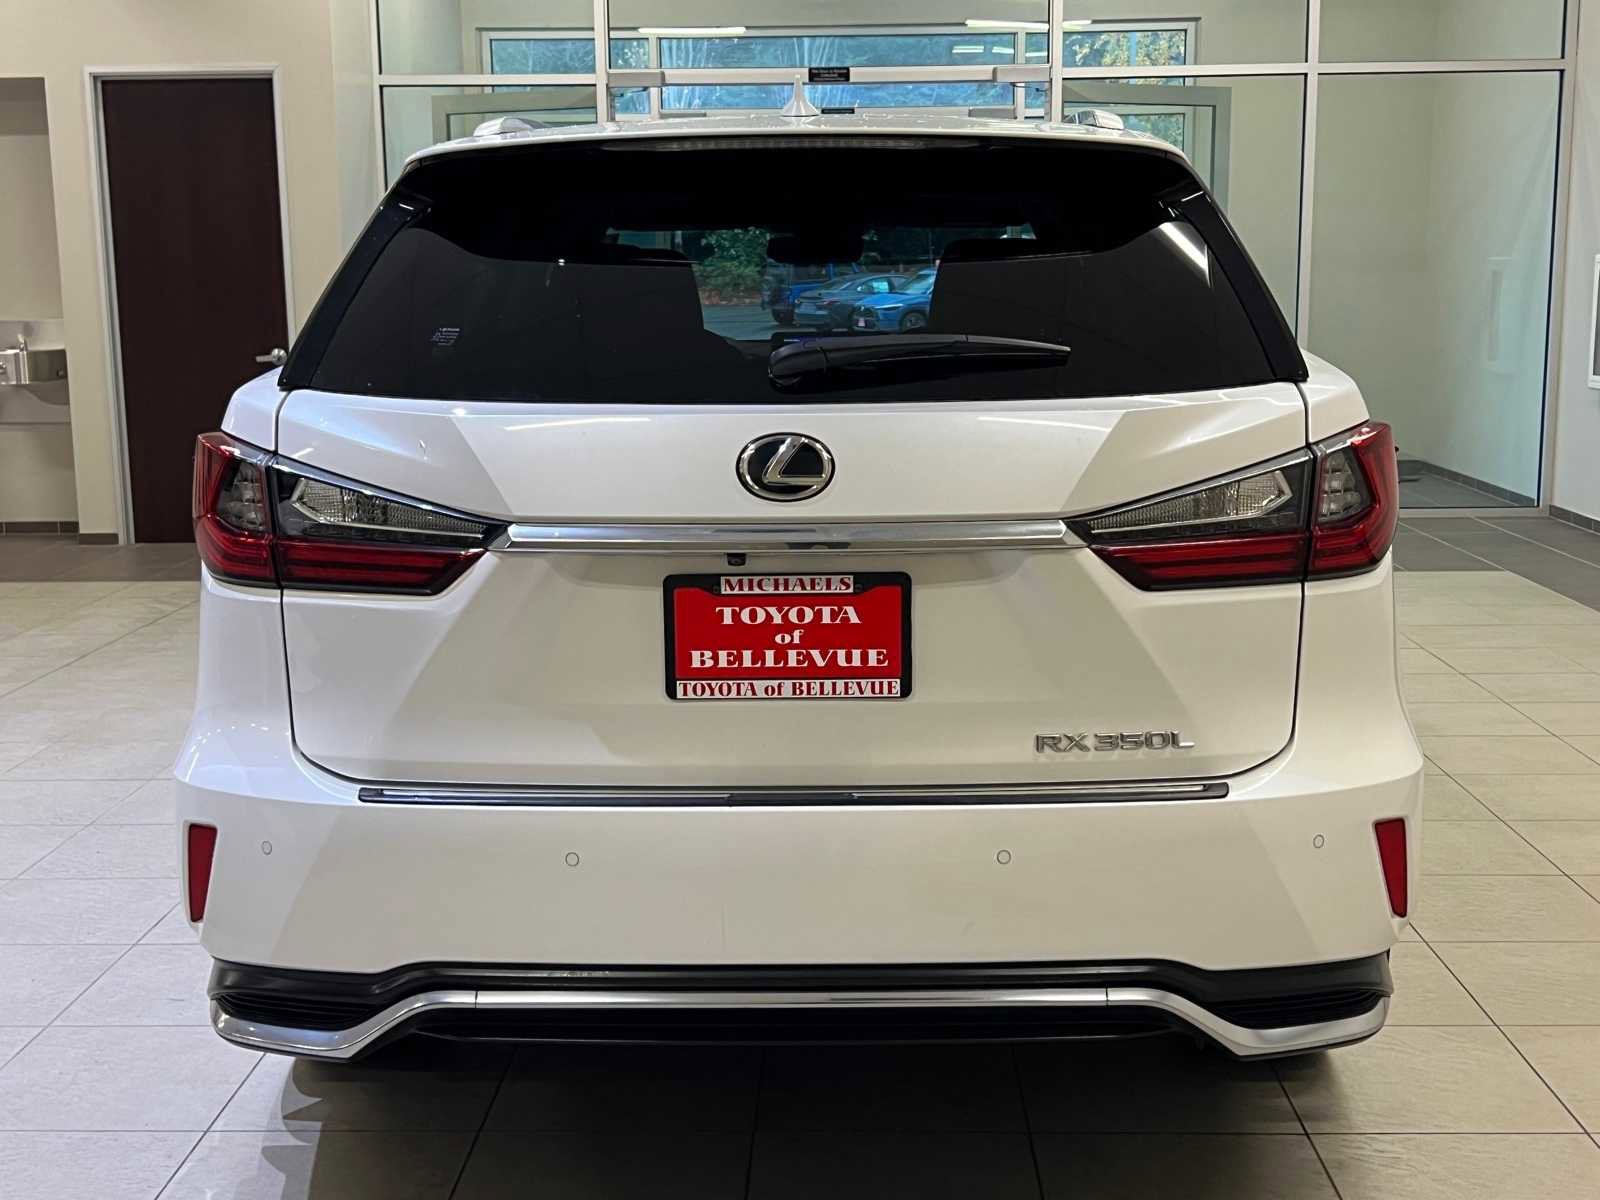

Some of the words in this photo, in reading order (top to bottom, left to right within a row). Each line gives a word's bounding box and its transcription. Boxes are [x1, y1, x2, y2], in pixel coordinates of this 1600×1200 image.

[723, 577, 851, 592] MICHAELS
[715, 606, 862, 625] TOYOTA
[774, 629, 805, 645] of
[690, 648, 889, 669] BELLEVUE
[678, 681, 758, 697] TOYOTA
[764, 680, 785, 697] of
[791, 680, 899, 696] BELLEVUE
[1035, 732, 1091, 753] RX
[1093, 729, 1195, 752] 350L
